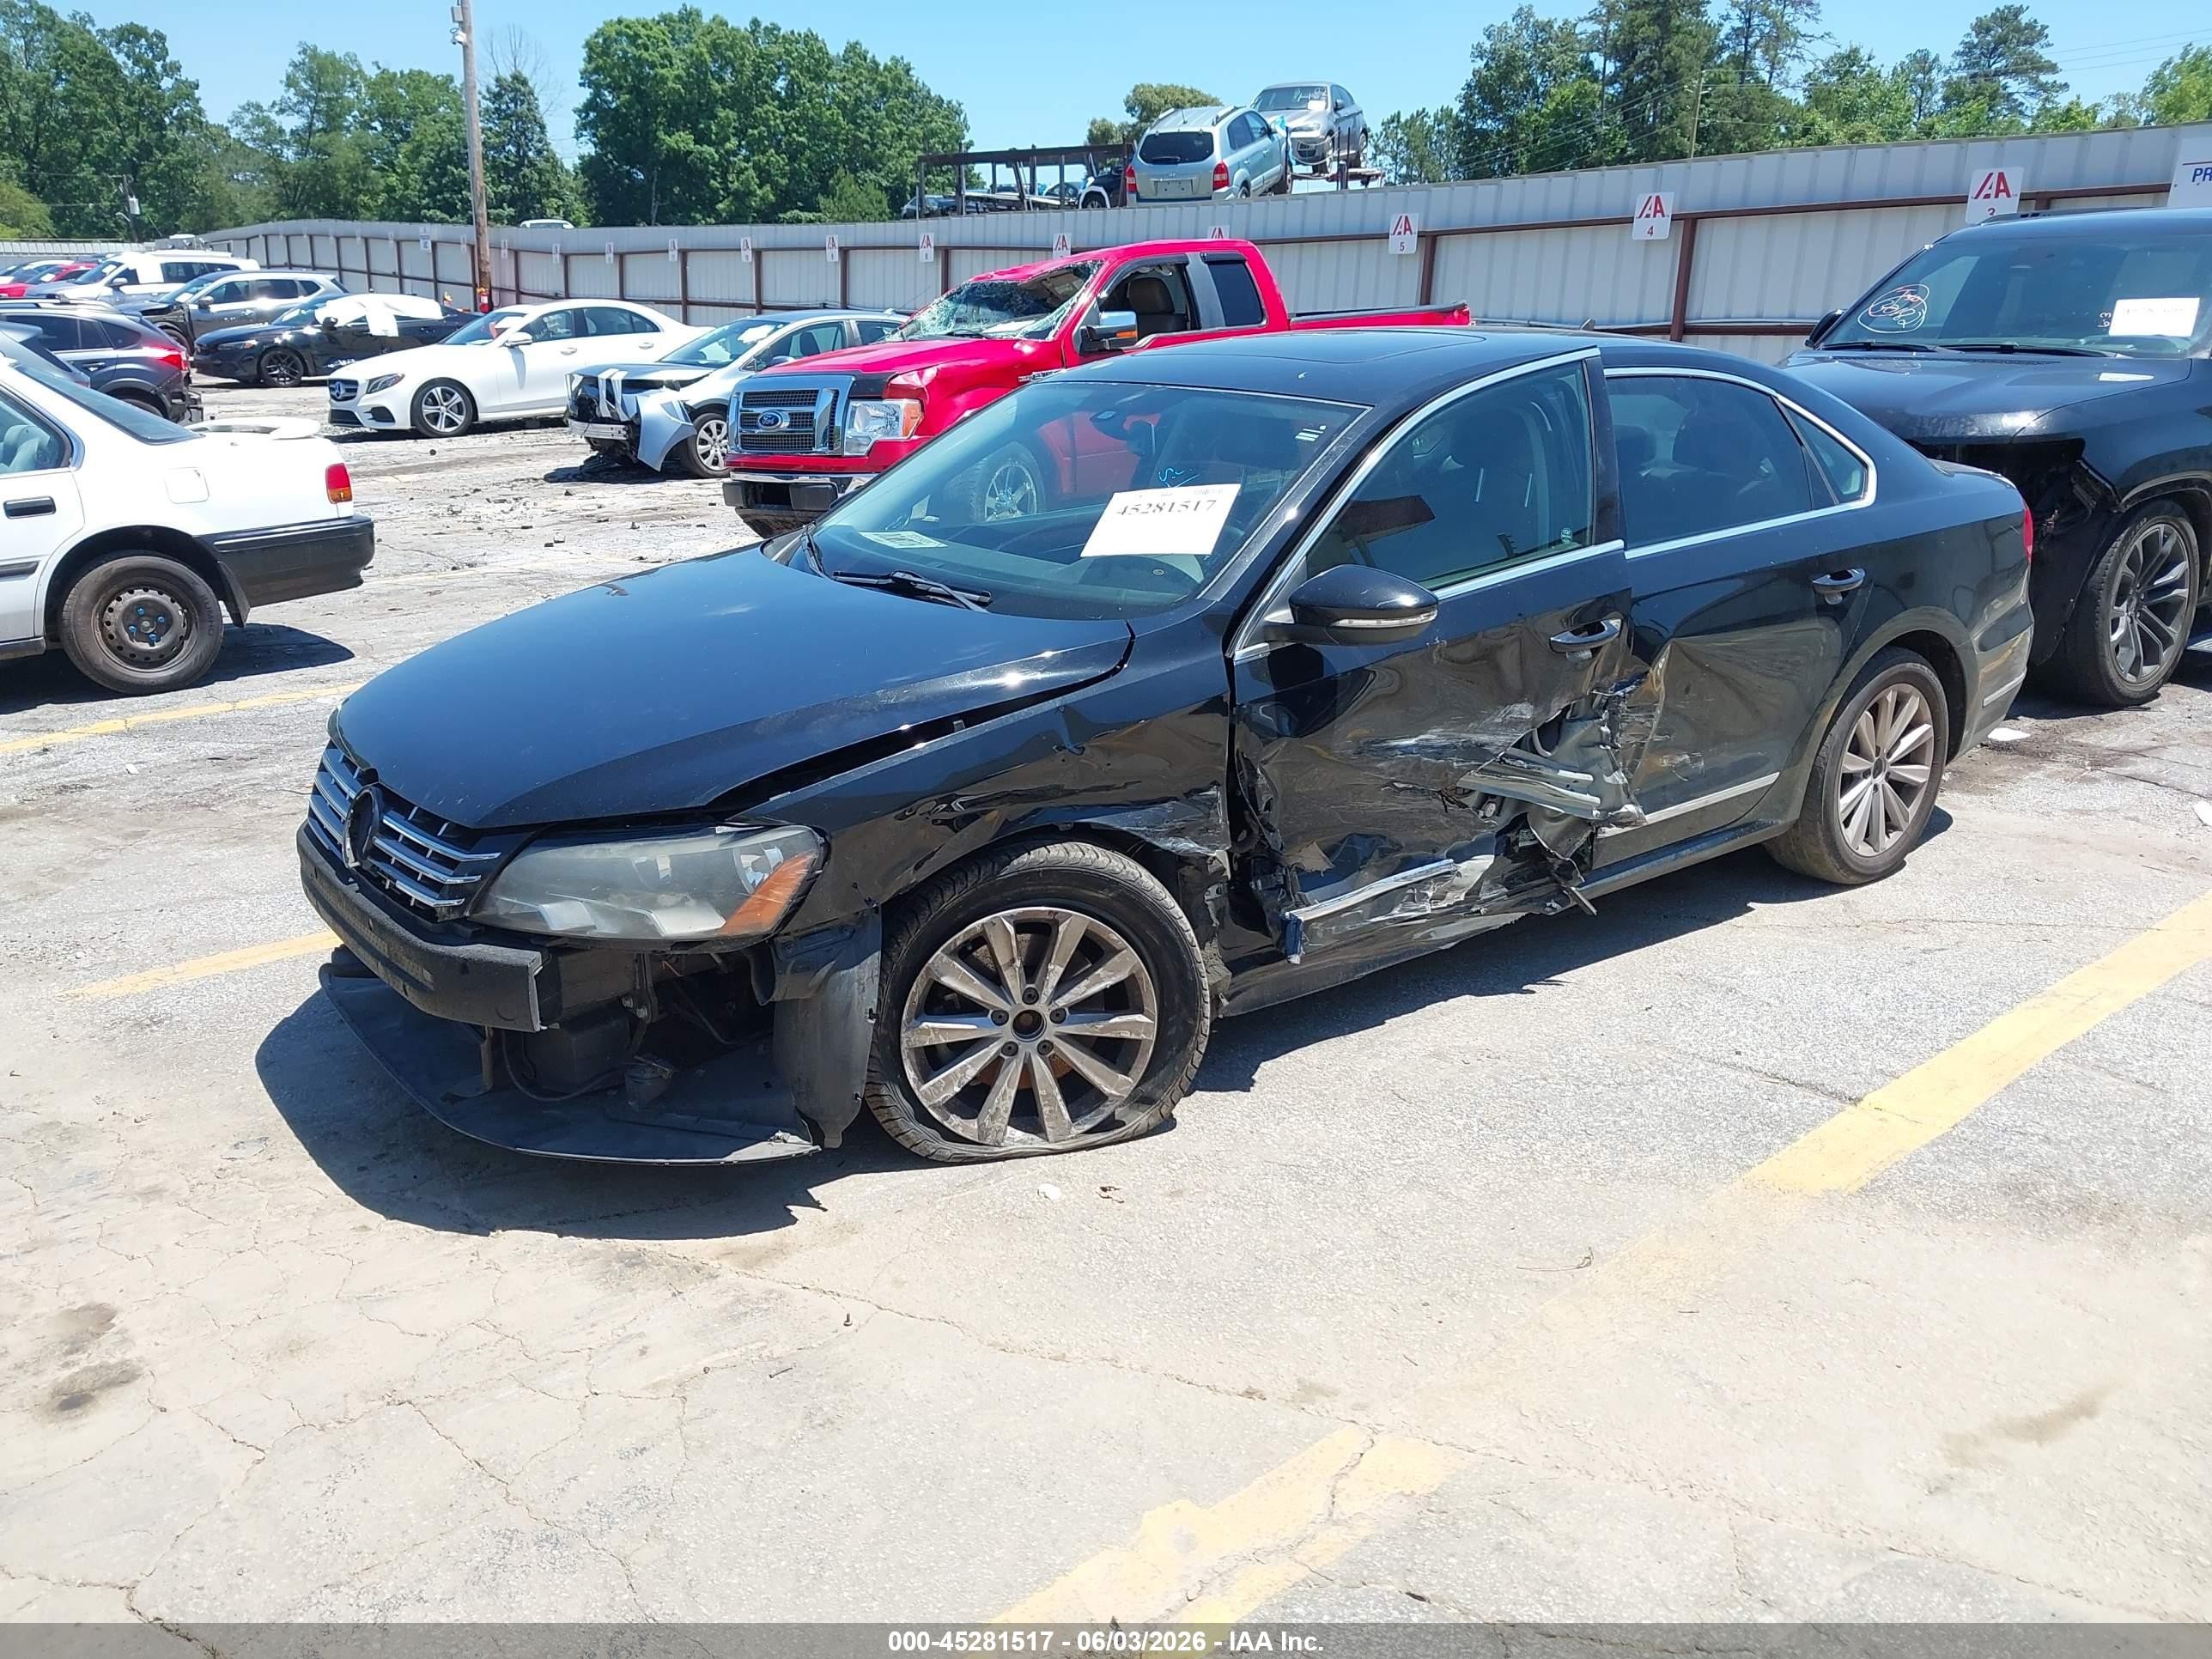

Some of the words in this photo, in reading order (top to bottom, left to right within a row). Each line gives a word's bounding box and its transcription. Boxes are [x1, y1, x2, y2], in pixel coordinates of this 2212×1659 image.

[1647, 226, 1654, 237] 4
[1400, 241, 1405, 252] 5
[1116, 499, 1218, 516] 45281517
